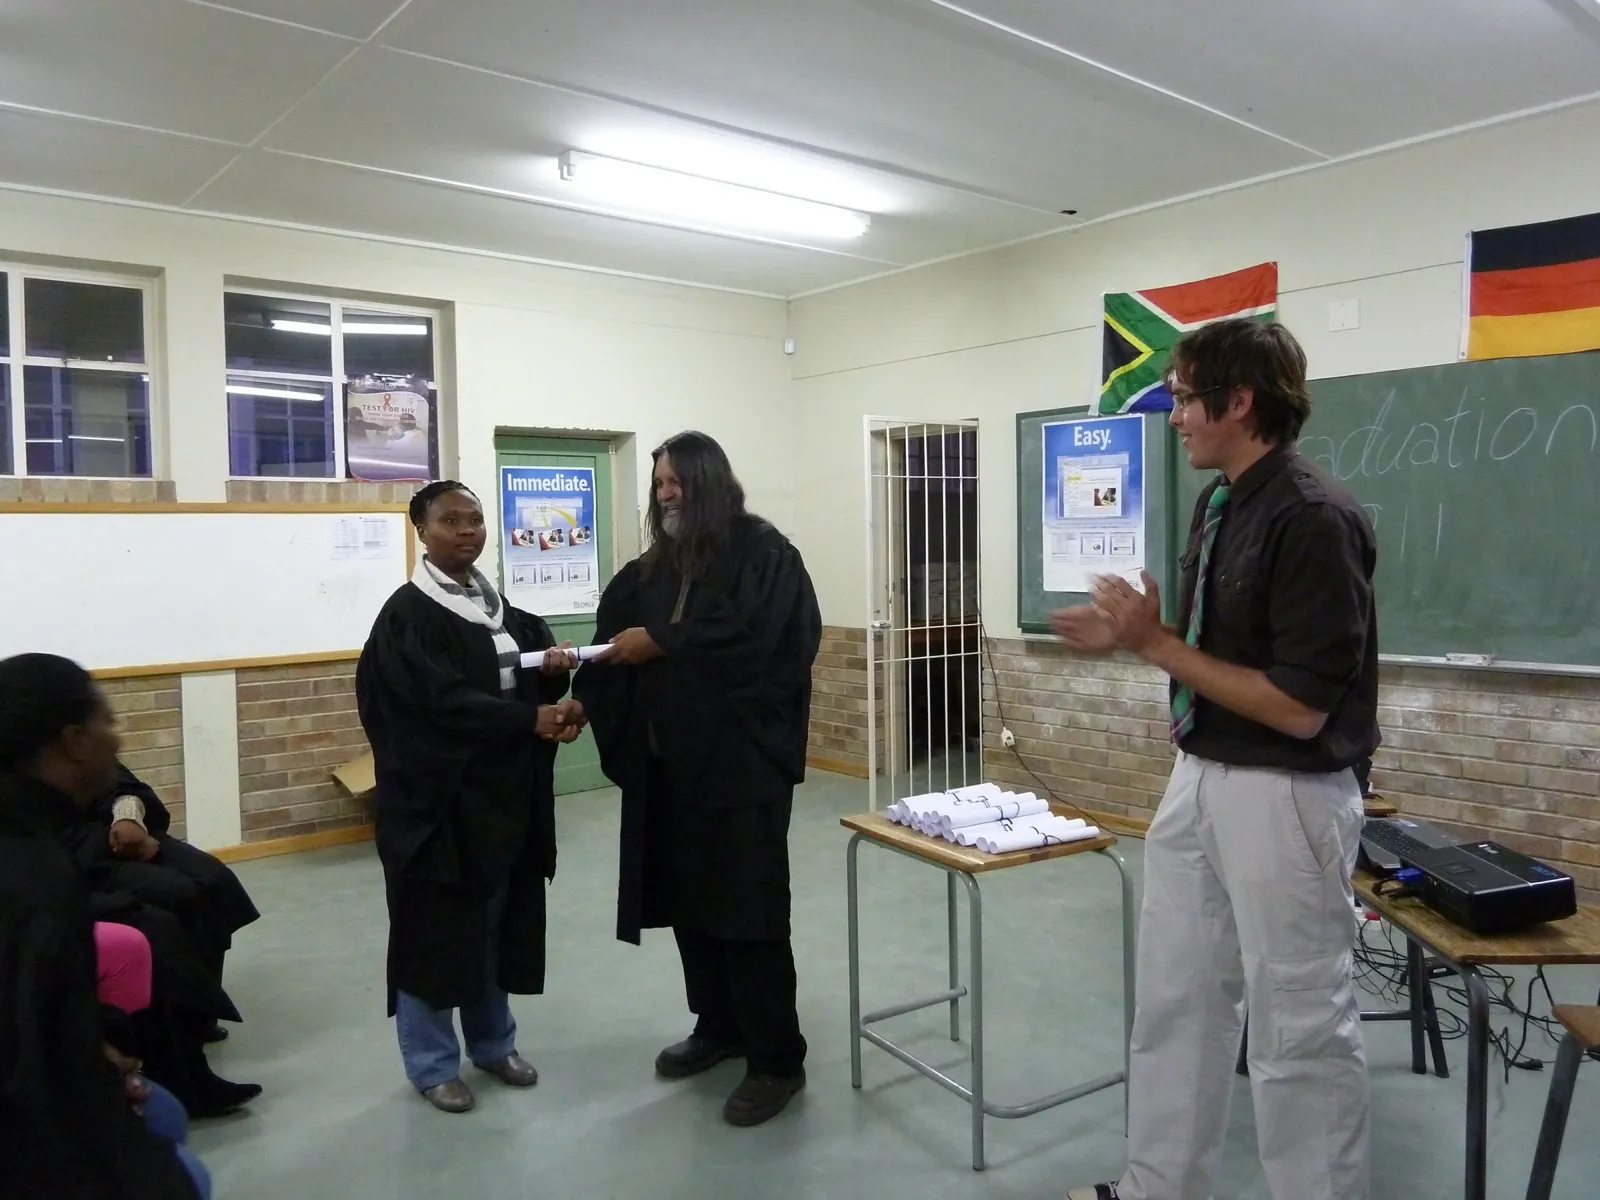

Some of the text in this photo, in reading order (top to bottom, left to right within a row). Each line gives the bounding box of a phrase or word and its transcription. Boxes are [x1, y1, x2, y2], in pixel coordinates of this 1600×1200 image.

[362, 404, 381, 412] TEST
[1074, 425, 1112, 451] Easy.
[507, 473, 591, 492] Immediate.
